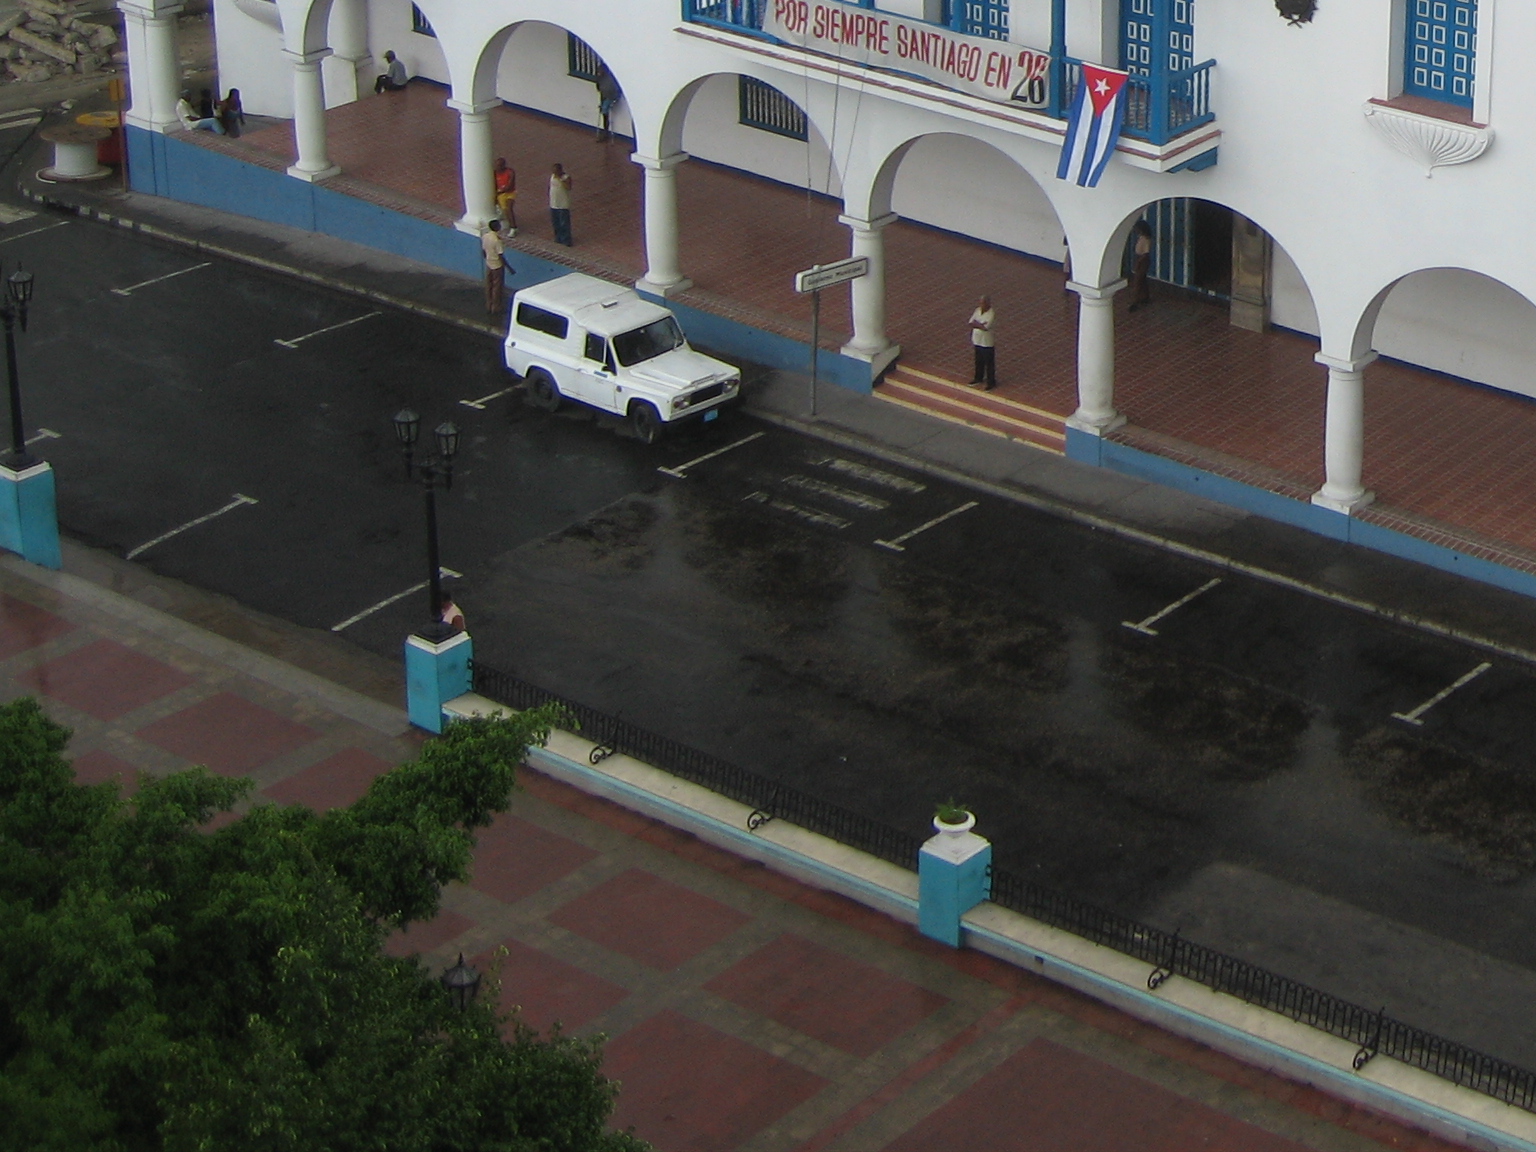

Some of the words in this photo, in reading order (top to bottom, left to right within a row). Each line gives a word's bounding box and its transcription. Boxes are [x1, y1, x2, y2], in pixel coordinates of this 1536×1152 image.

[813, 5, 890, 54] SIEMPRE
[897, 25, 982, 82] SANTIAGO
[984, 51, 1012, 90] EN
[1011, 51, 1050, 104] 26
